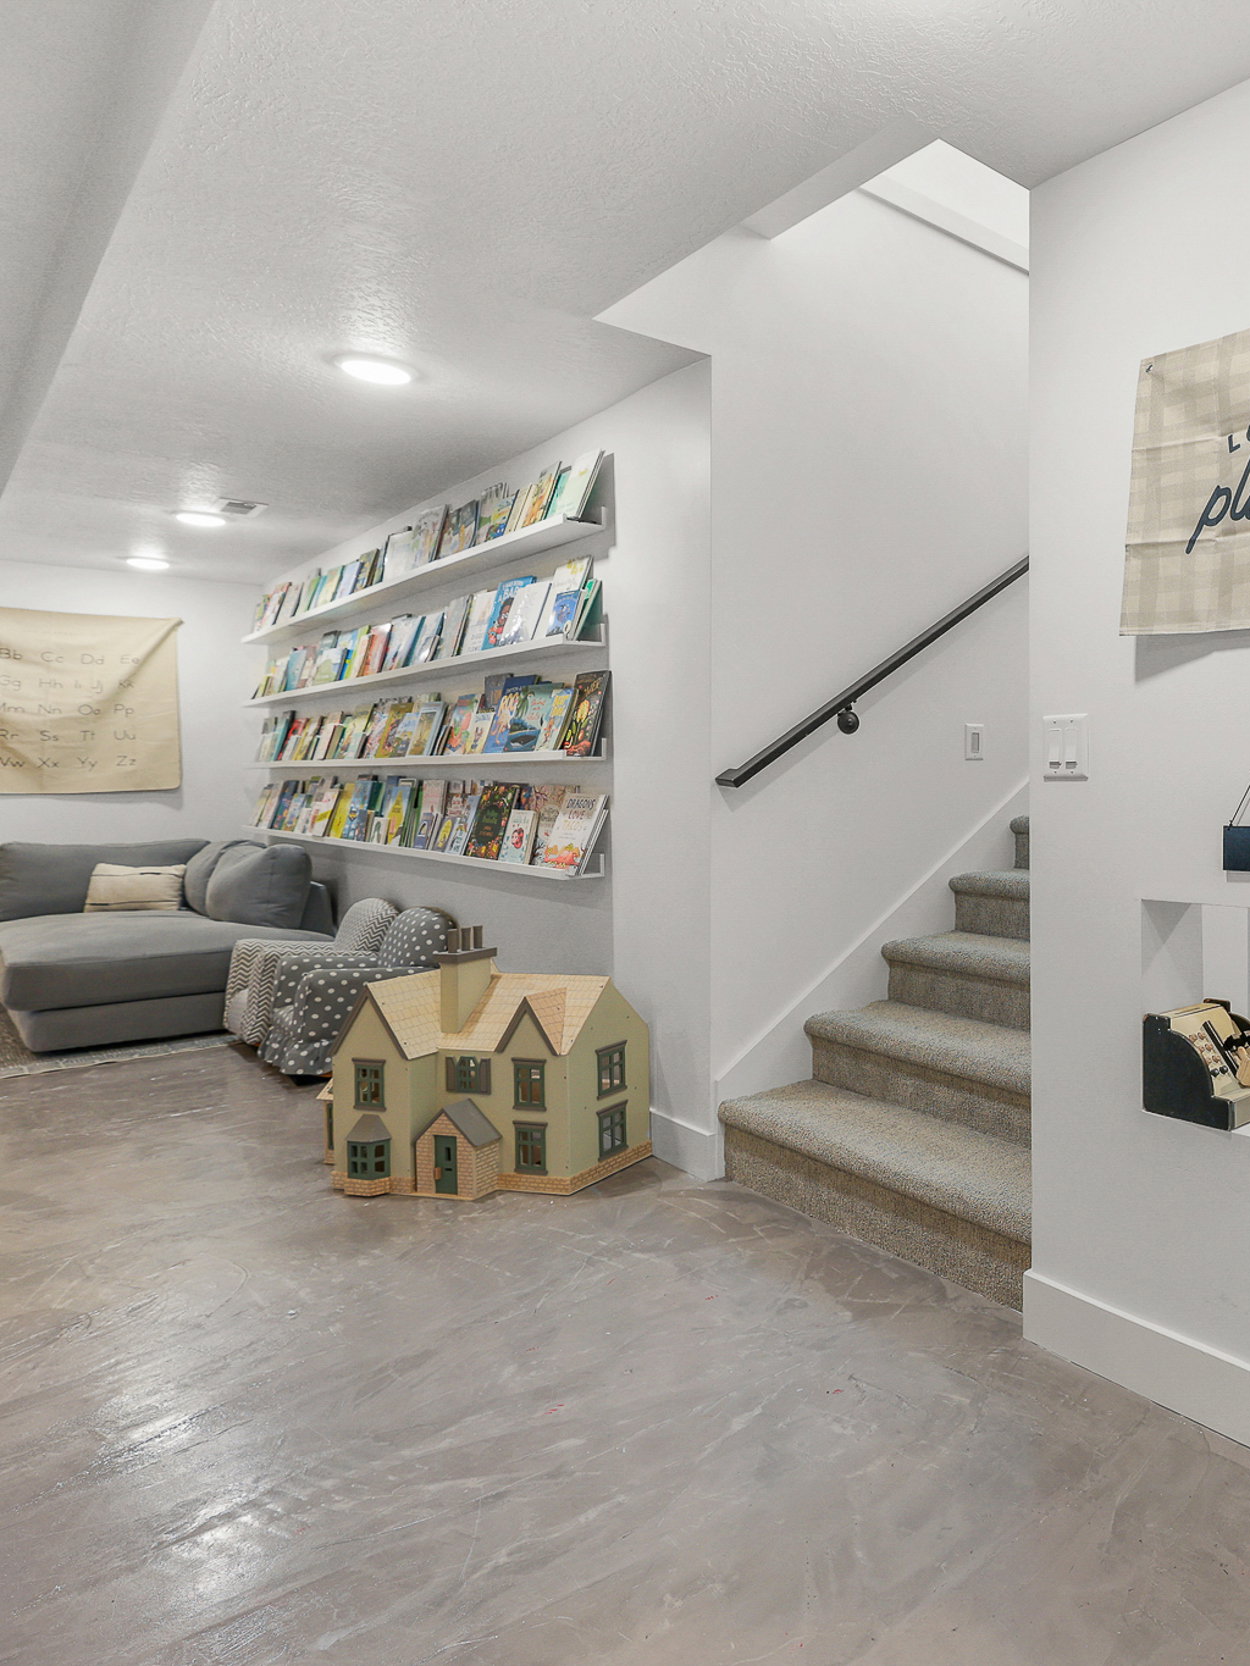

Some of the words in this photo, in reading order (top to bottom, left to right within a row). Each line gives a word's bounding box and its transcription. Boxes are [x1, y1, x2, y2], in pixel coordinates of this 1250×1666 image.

[0, 647, 23, 660] Bb
[40, 651, 64, 664] Cc
[81, 653, 104, 665] Dd
[120, 654, 140, 665] Ee
[39, 678, 63, 688] Hh
[38, 703, 62, 714] Nn
[78, 703, 101, 716] Oo
[113, 703, 134, 718] Pp
[0, 728, 19, 740] Rr
[40, 730, 59, 741] Ss
[80, 730, 95, 741] Tt
[113, 729, 136, 741] Uu
[38, 757, 59, 768] Xx
[76, 757, 98, 771] Yy
[116, 755, 136, 766] Zz
[566, 798, 597, 811] DRAGONS
[568, 809, 586, 820] LOVE
